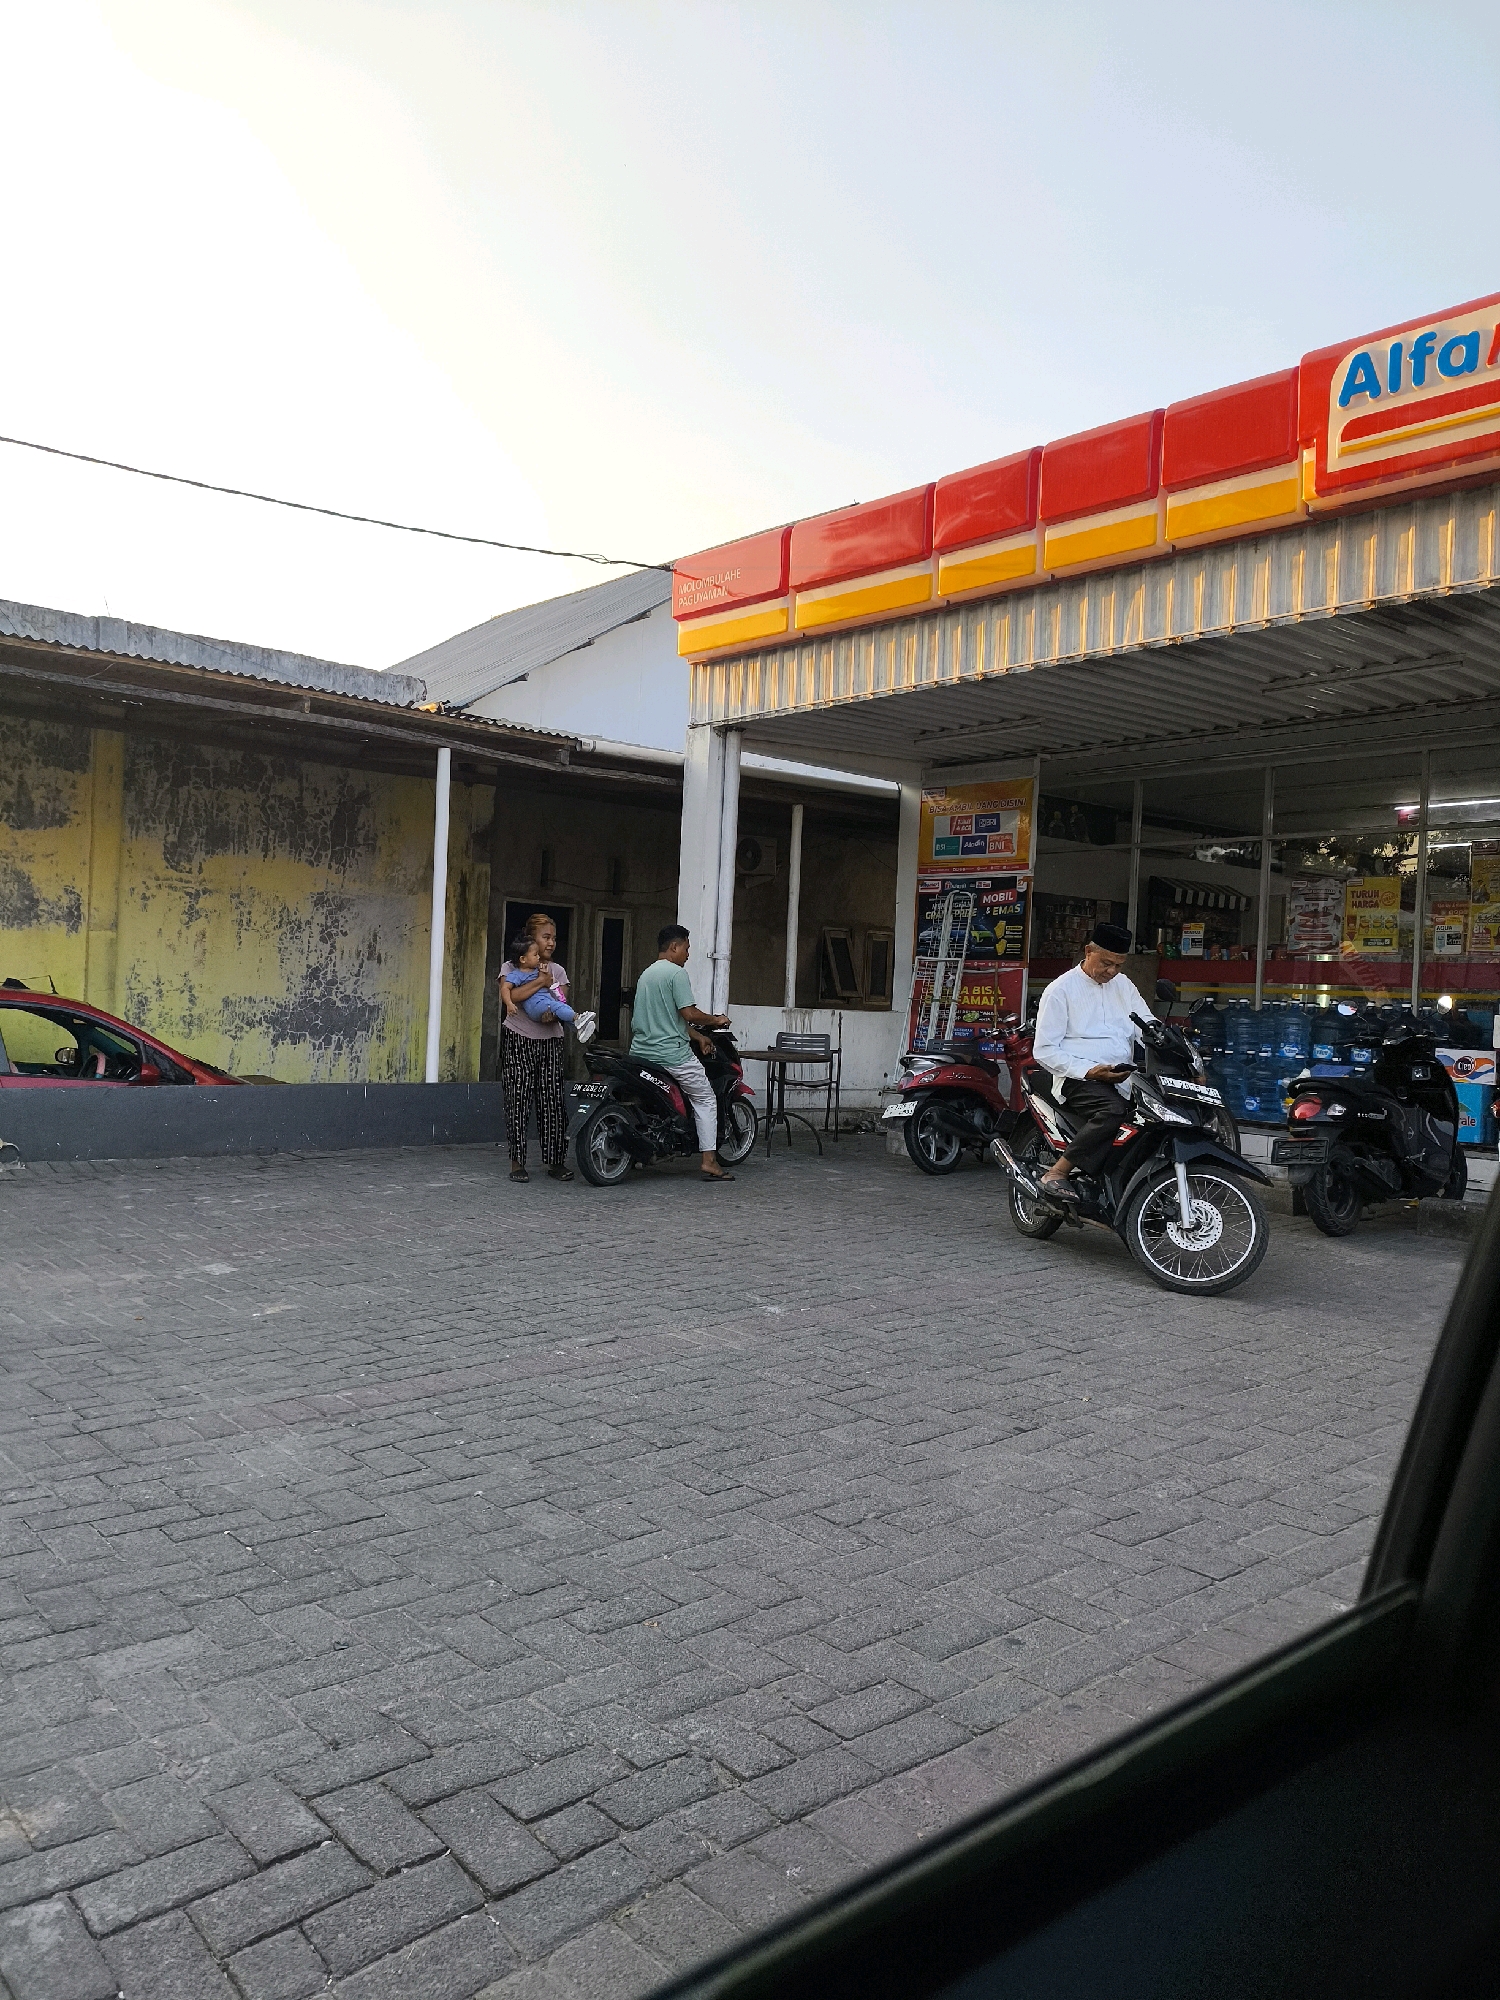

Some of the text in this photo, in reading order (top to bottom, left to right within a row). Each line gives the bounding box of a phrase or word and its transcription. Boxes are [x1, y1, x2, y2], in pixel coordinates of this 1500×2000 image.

[1338, 323, 1500, 408] Alfa
[678, 568, 741, 595] MOLOMBULAHE
[678, 586, 728, 608] PAGUYAMAN
[929, 797, 1027, 814] BISA AMBIL UANG DISINI
[989, 842, 1005, 851] BNI
[982, 891, 1014, 904] MOBIL
[1351, 889, 1380, 899] TURUN
[985, 903, 1021, 916] & EMAS
[1352, 900, 1380, 909] HARGA
